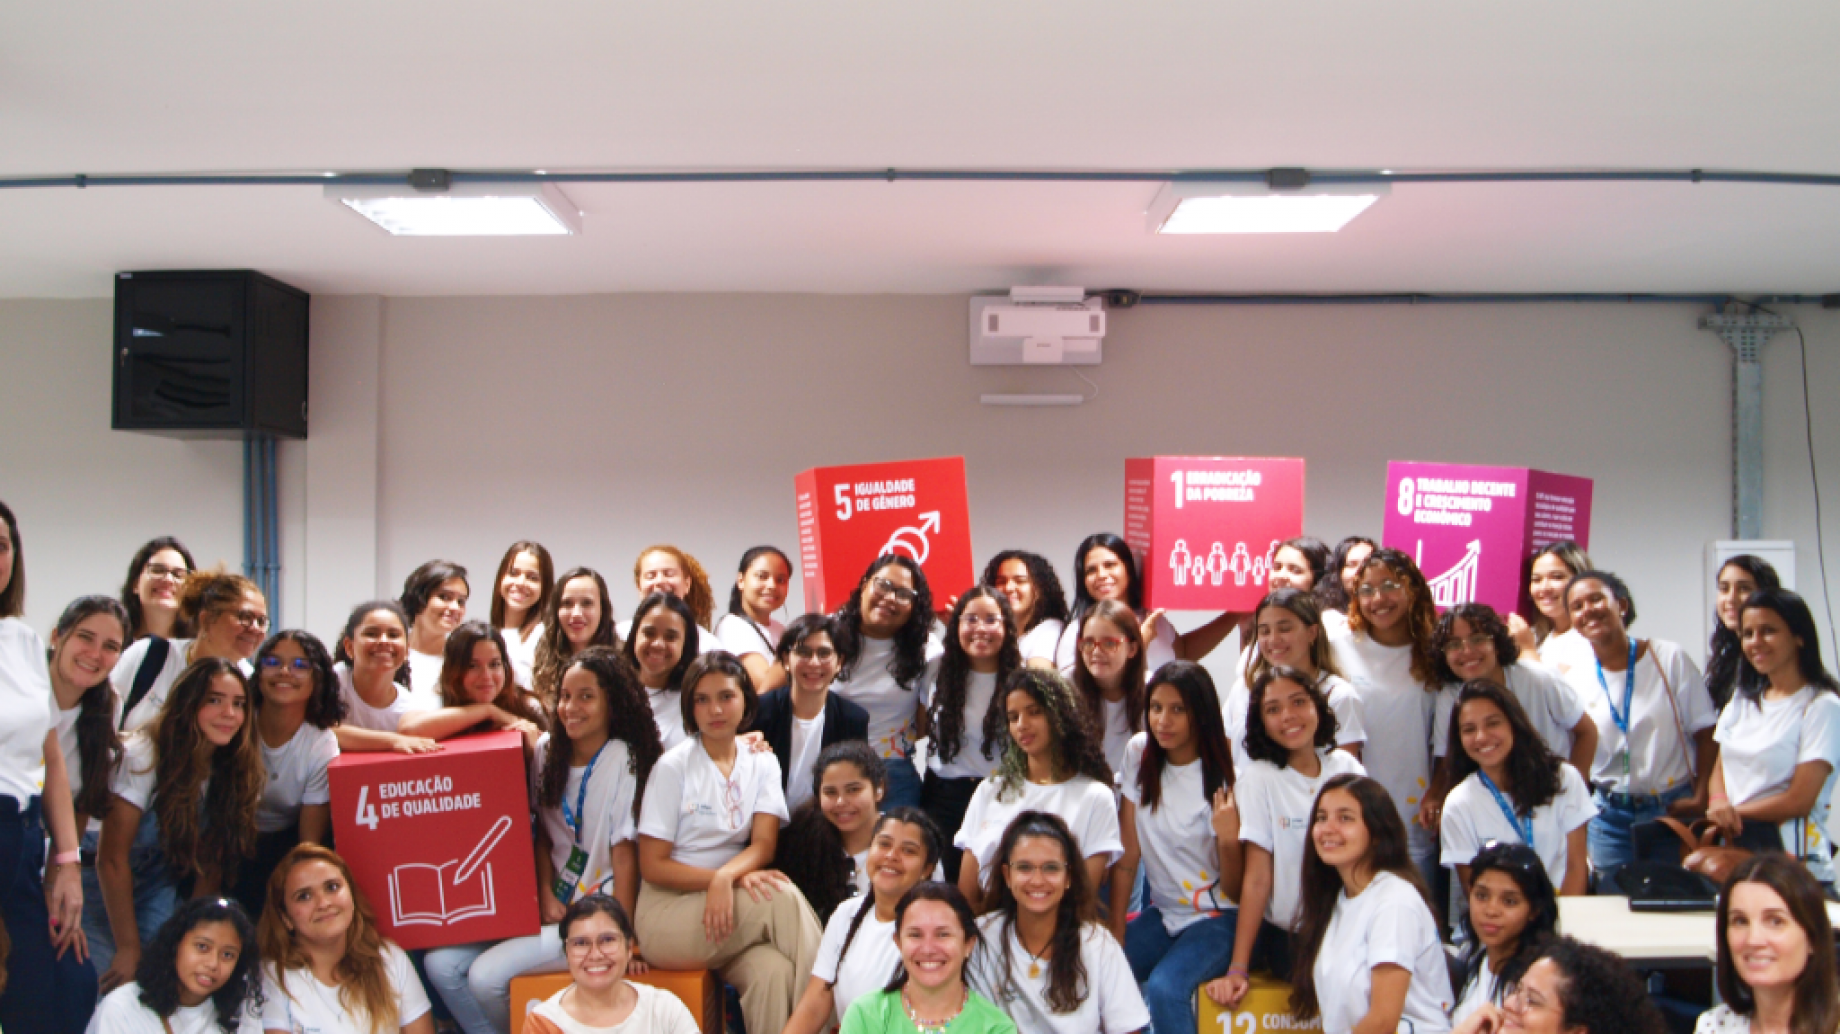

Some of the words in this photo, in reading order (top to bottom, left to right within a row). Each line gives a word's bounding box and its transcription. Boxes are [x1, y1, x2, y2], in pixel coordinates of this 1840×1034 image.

[854, 478, 915, 496] IGUALDADE
[1170, 470, 1183, 509] 1
[1185, 486, 1203, 501] DA
[1203, 486, 1254, 502] POBREZA
[1398, 476, 1415, 516] 8
[1416, 477, 1470, 494] TRABALHO
[1470, 481, 1516, 498] DECENTE
[834, 483, 852, 521] 5
[856, 497, 871, 512] DE
[872, 493, 916, 511] GÊNERO
[1415, 493, 1422, 508] E
[1424, 494, 1492, 512] CRESCIMENTO
[1414, 508, 1472, 527] ECONÔMICO
[379, 774, 453, 800] EDUCAÇÃO
[356, 785, 379, 831] 4
[381, 801, 400, 819] DE
[402, 792, 481, 818] QUALIDADE
[1216, 1010, 1257, 1034] 12
